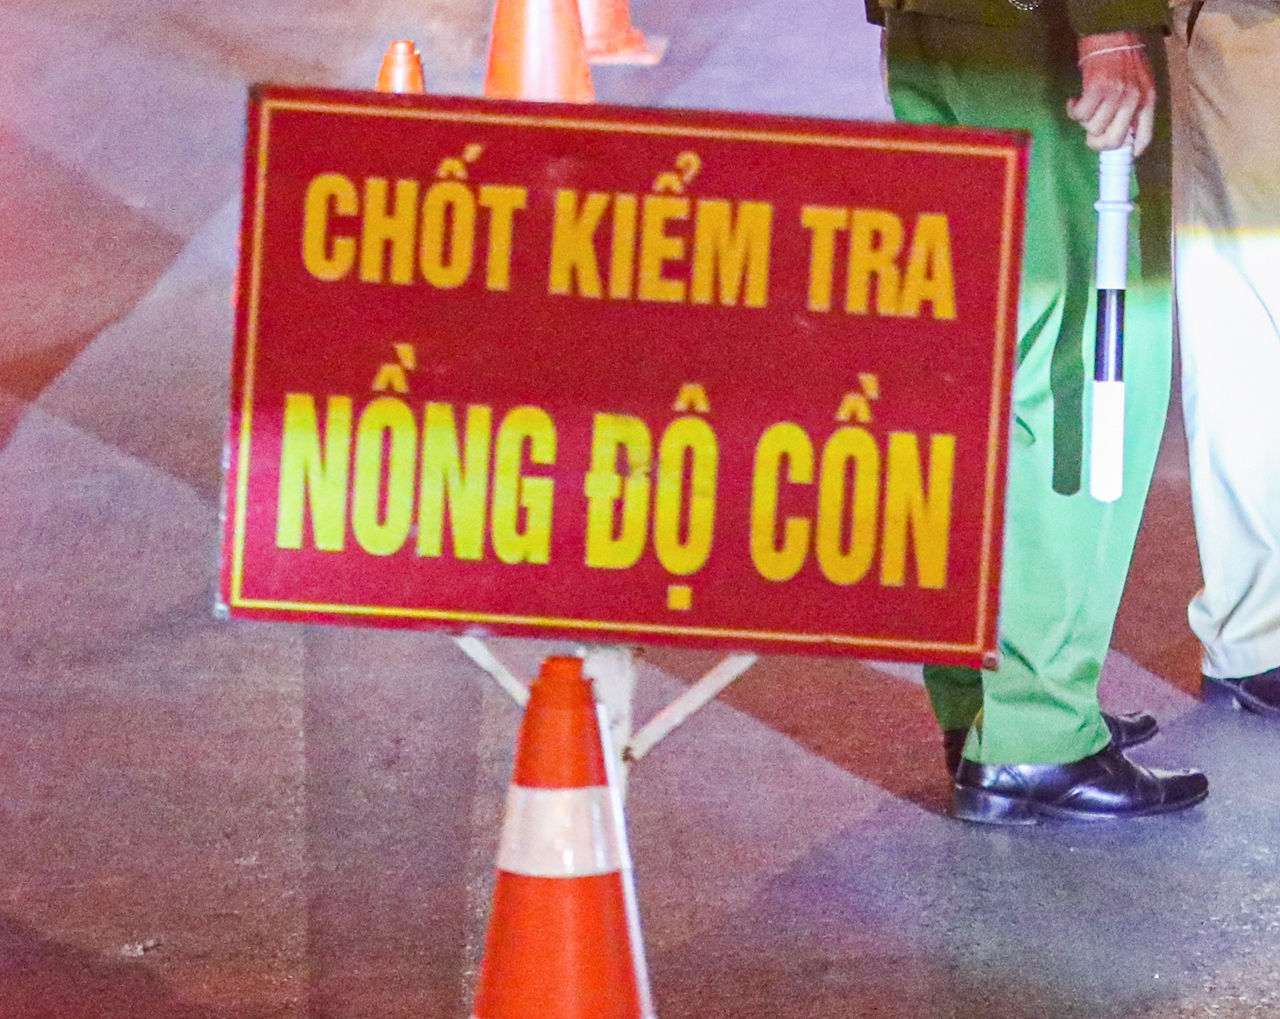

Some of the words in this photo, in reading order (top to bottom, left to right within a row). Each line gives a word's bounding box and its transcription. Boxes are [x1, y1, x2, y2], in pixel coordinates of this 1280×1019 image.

[302, 144, 527, 291] CHỐT
[548, 152, 773, 308] KIỂM
[800, 205, 957, 320] TRA
[276, 343, 557, 565] NỒNG
[584, 384, 720, 611] ĐỘ
[750, 373, 956, 590] CỒN
